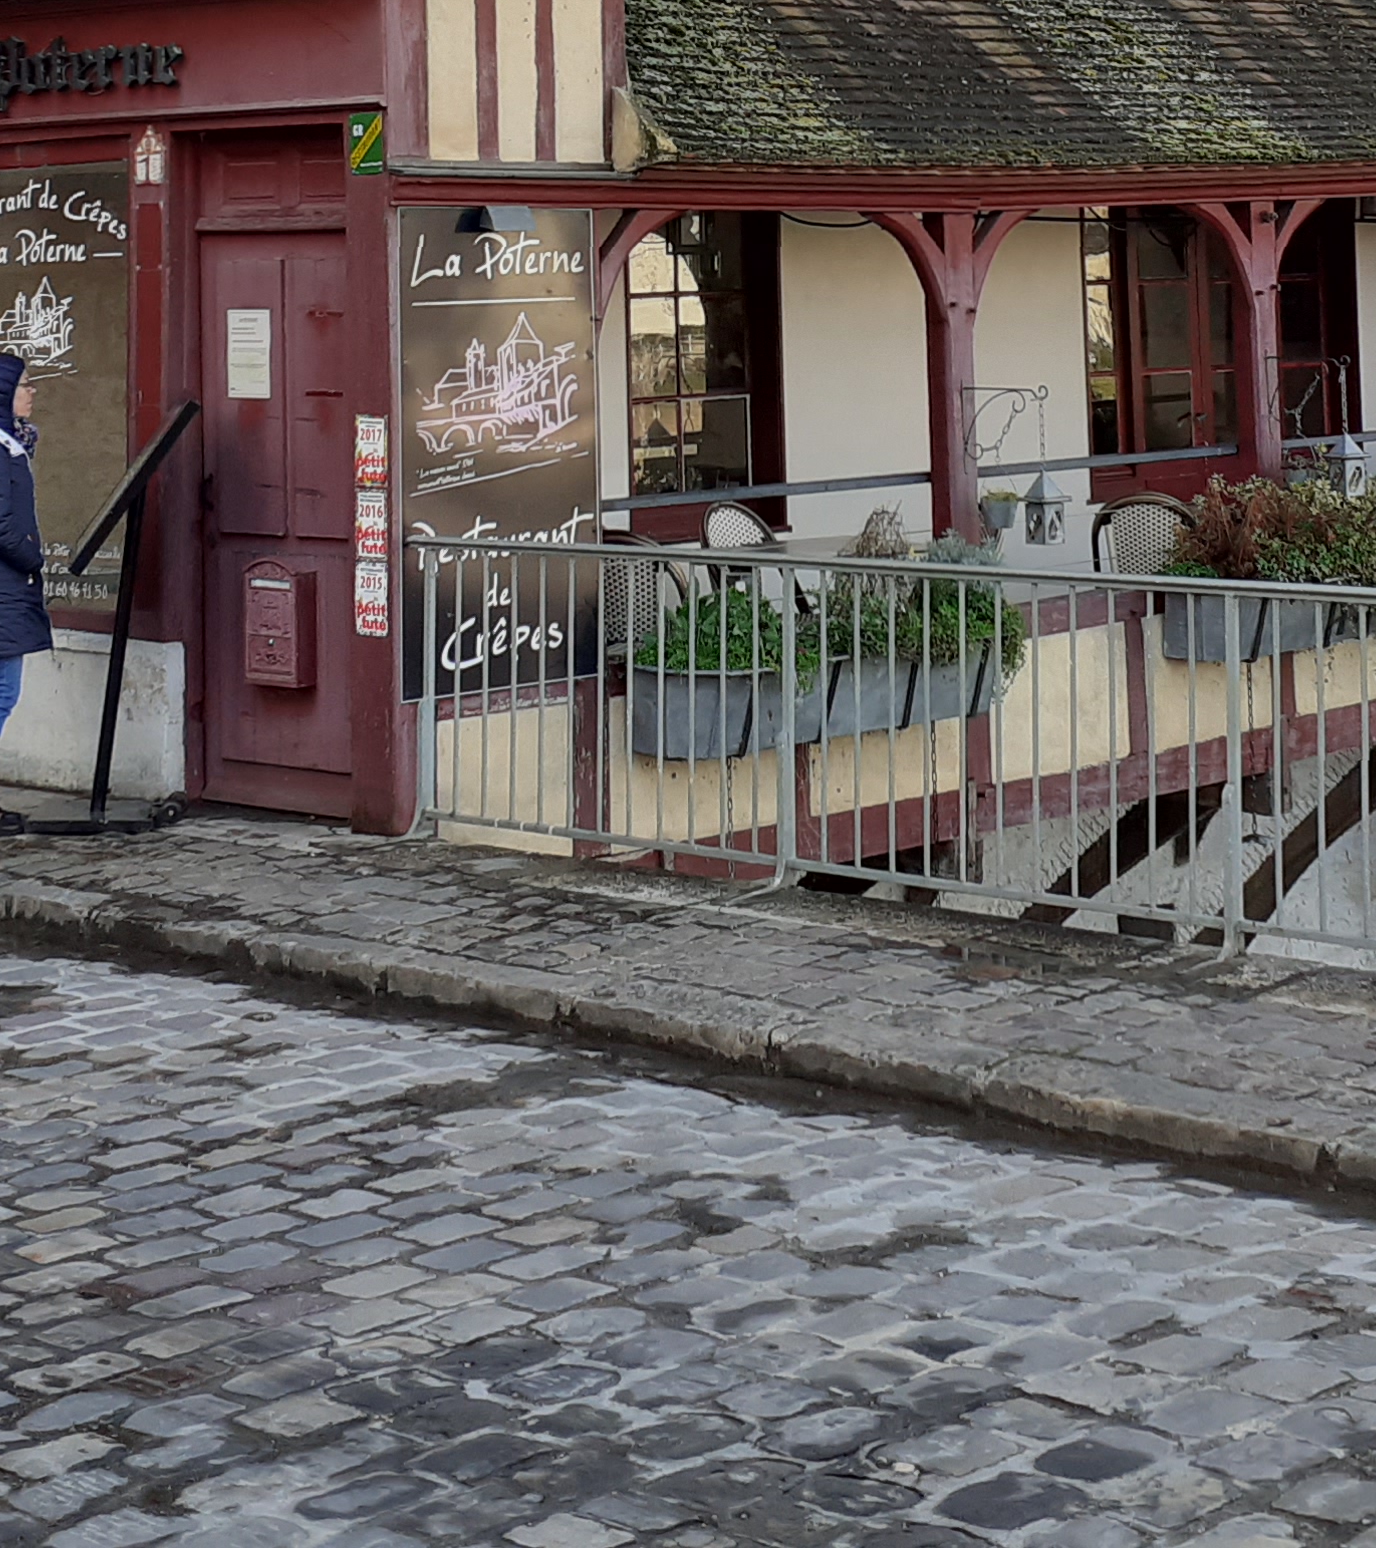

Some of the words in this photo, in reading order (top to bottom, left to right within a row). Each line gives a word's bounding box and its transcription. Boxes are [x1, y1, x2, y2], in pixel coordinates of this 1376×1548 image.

[38, 179, 59, 210] de
[63, 190, 128, 240] Crêpes
[15, 228, 87, 267] Poterne
[410, 233, 462, 288] La
[474, 231, 585, 280] Poterne
[359, 428, 383, 442] 2017
[359, 504, 384, 519] 2016
[359, 575, 383, 591] 2015
[486, 571, 512, 608] de
[441, 615, 564, 672] Crêpes
